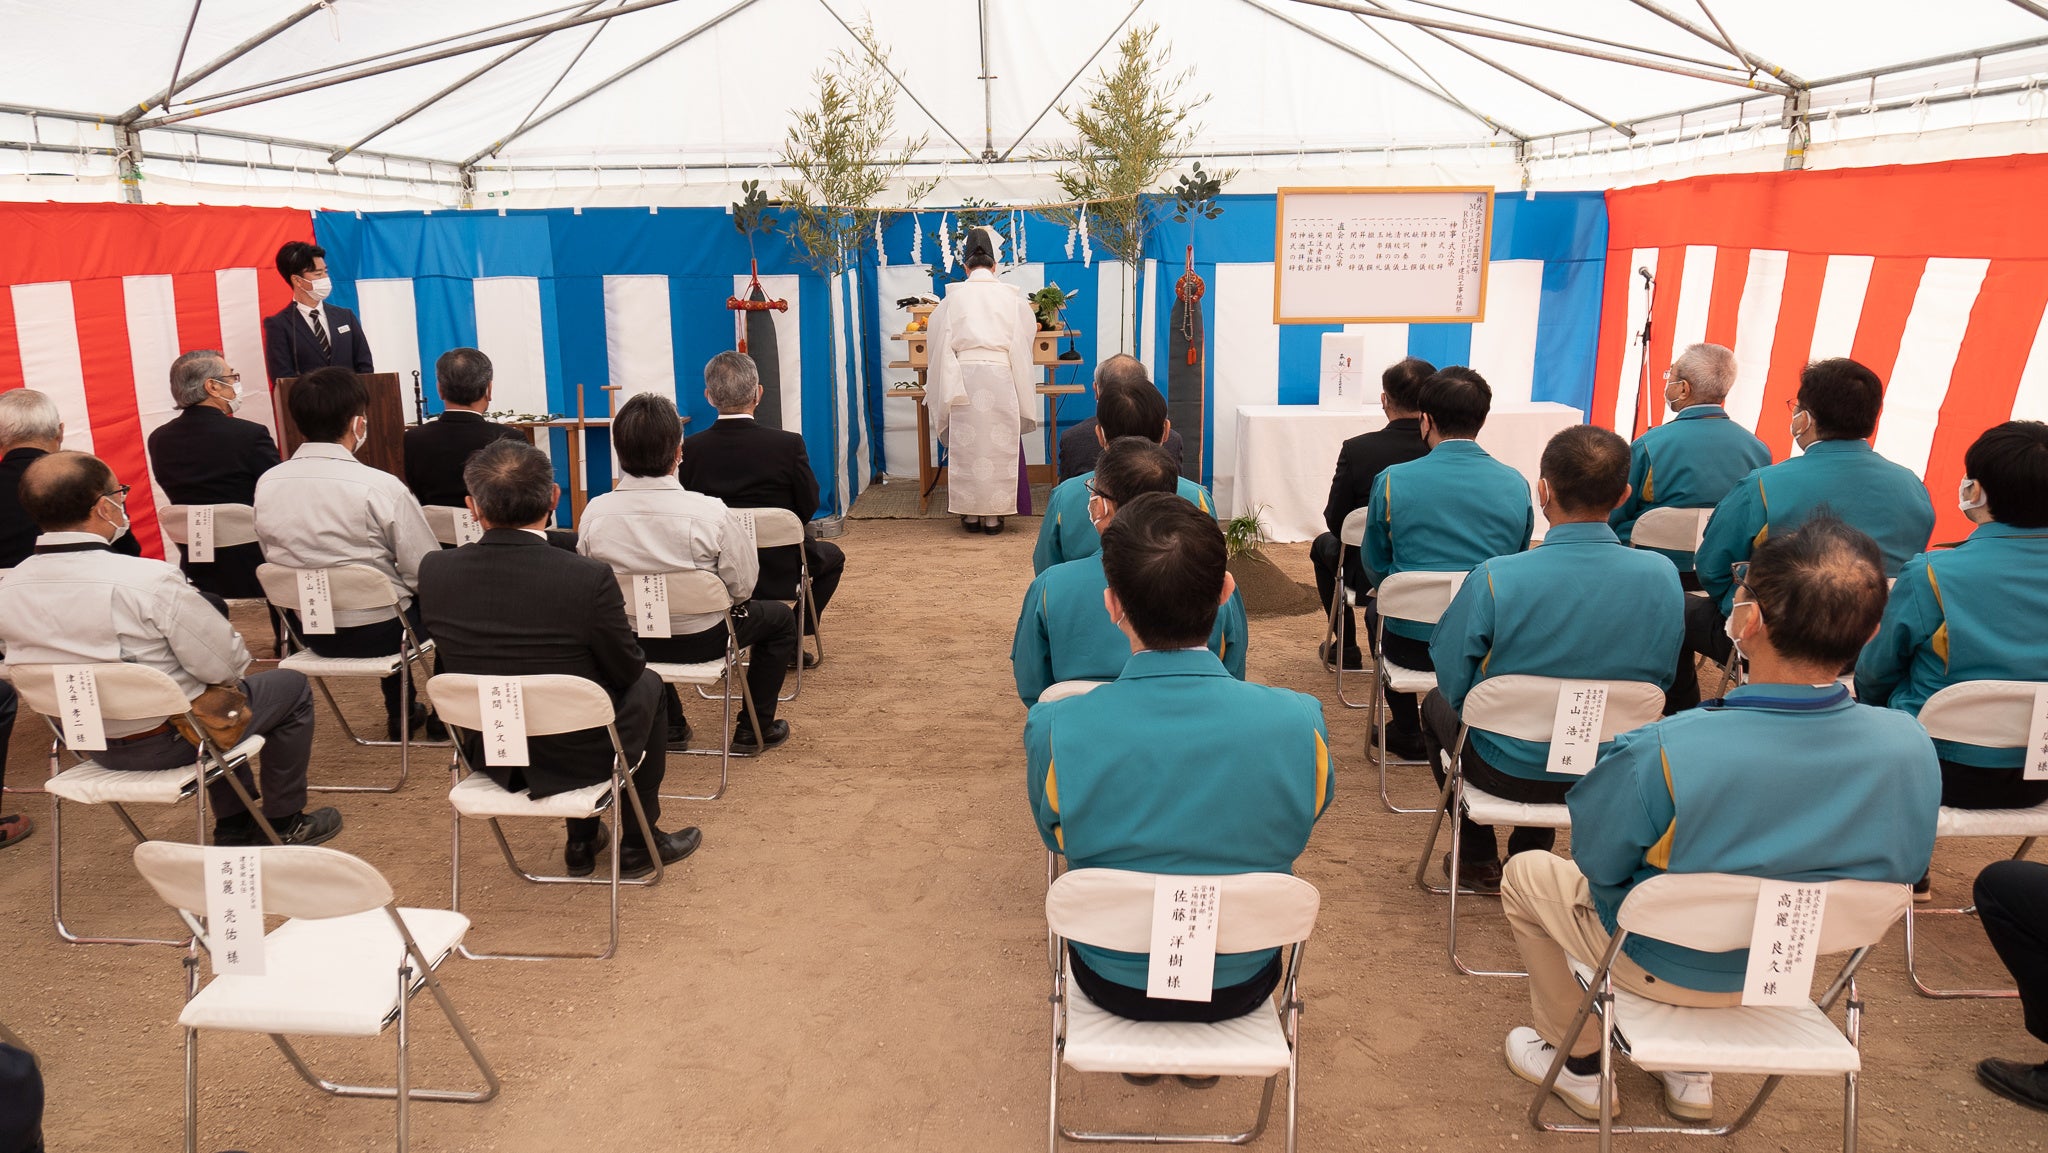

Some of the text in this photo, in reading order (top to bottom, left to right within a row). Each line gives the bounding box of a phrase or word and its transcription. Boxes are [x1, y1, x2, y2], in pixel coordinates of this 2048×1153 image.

[304, 573, 314, 591] 小山
[642, 575, 651, 594] 青木
[66, 674, 87, 743] 津久井 孝二 様
[491, 686, 508, 759] 高間 弘文 様
[1561, 692, 1584, 766] 下山 浩一 様
[221, 861, 239, 965] 高麗 亮佑 様
[1189, 885, 1199, 921] 工場総務課
[1198, 885, 1208, 914] 管理本部
[1207, 885, 1216, 931] 株式会社ヨコオ
[1809, 888, 1821, 935] 株式会社ヨコオ
[1167, 889, 1188, 989] 佐藤 洋樹 様
[1763, 893, 1791, 996] 高麗 良久 様
